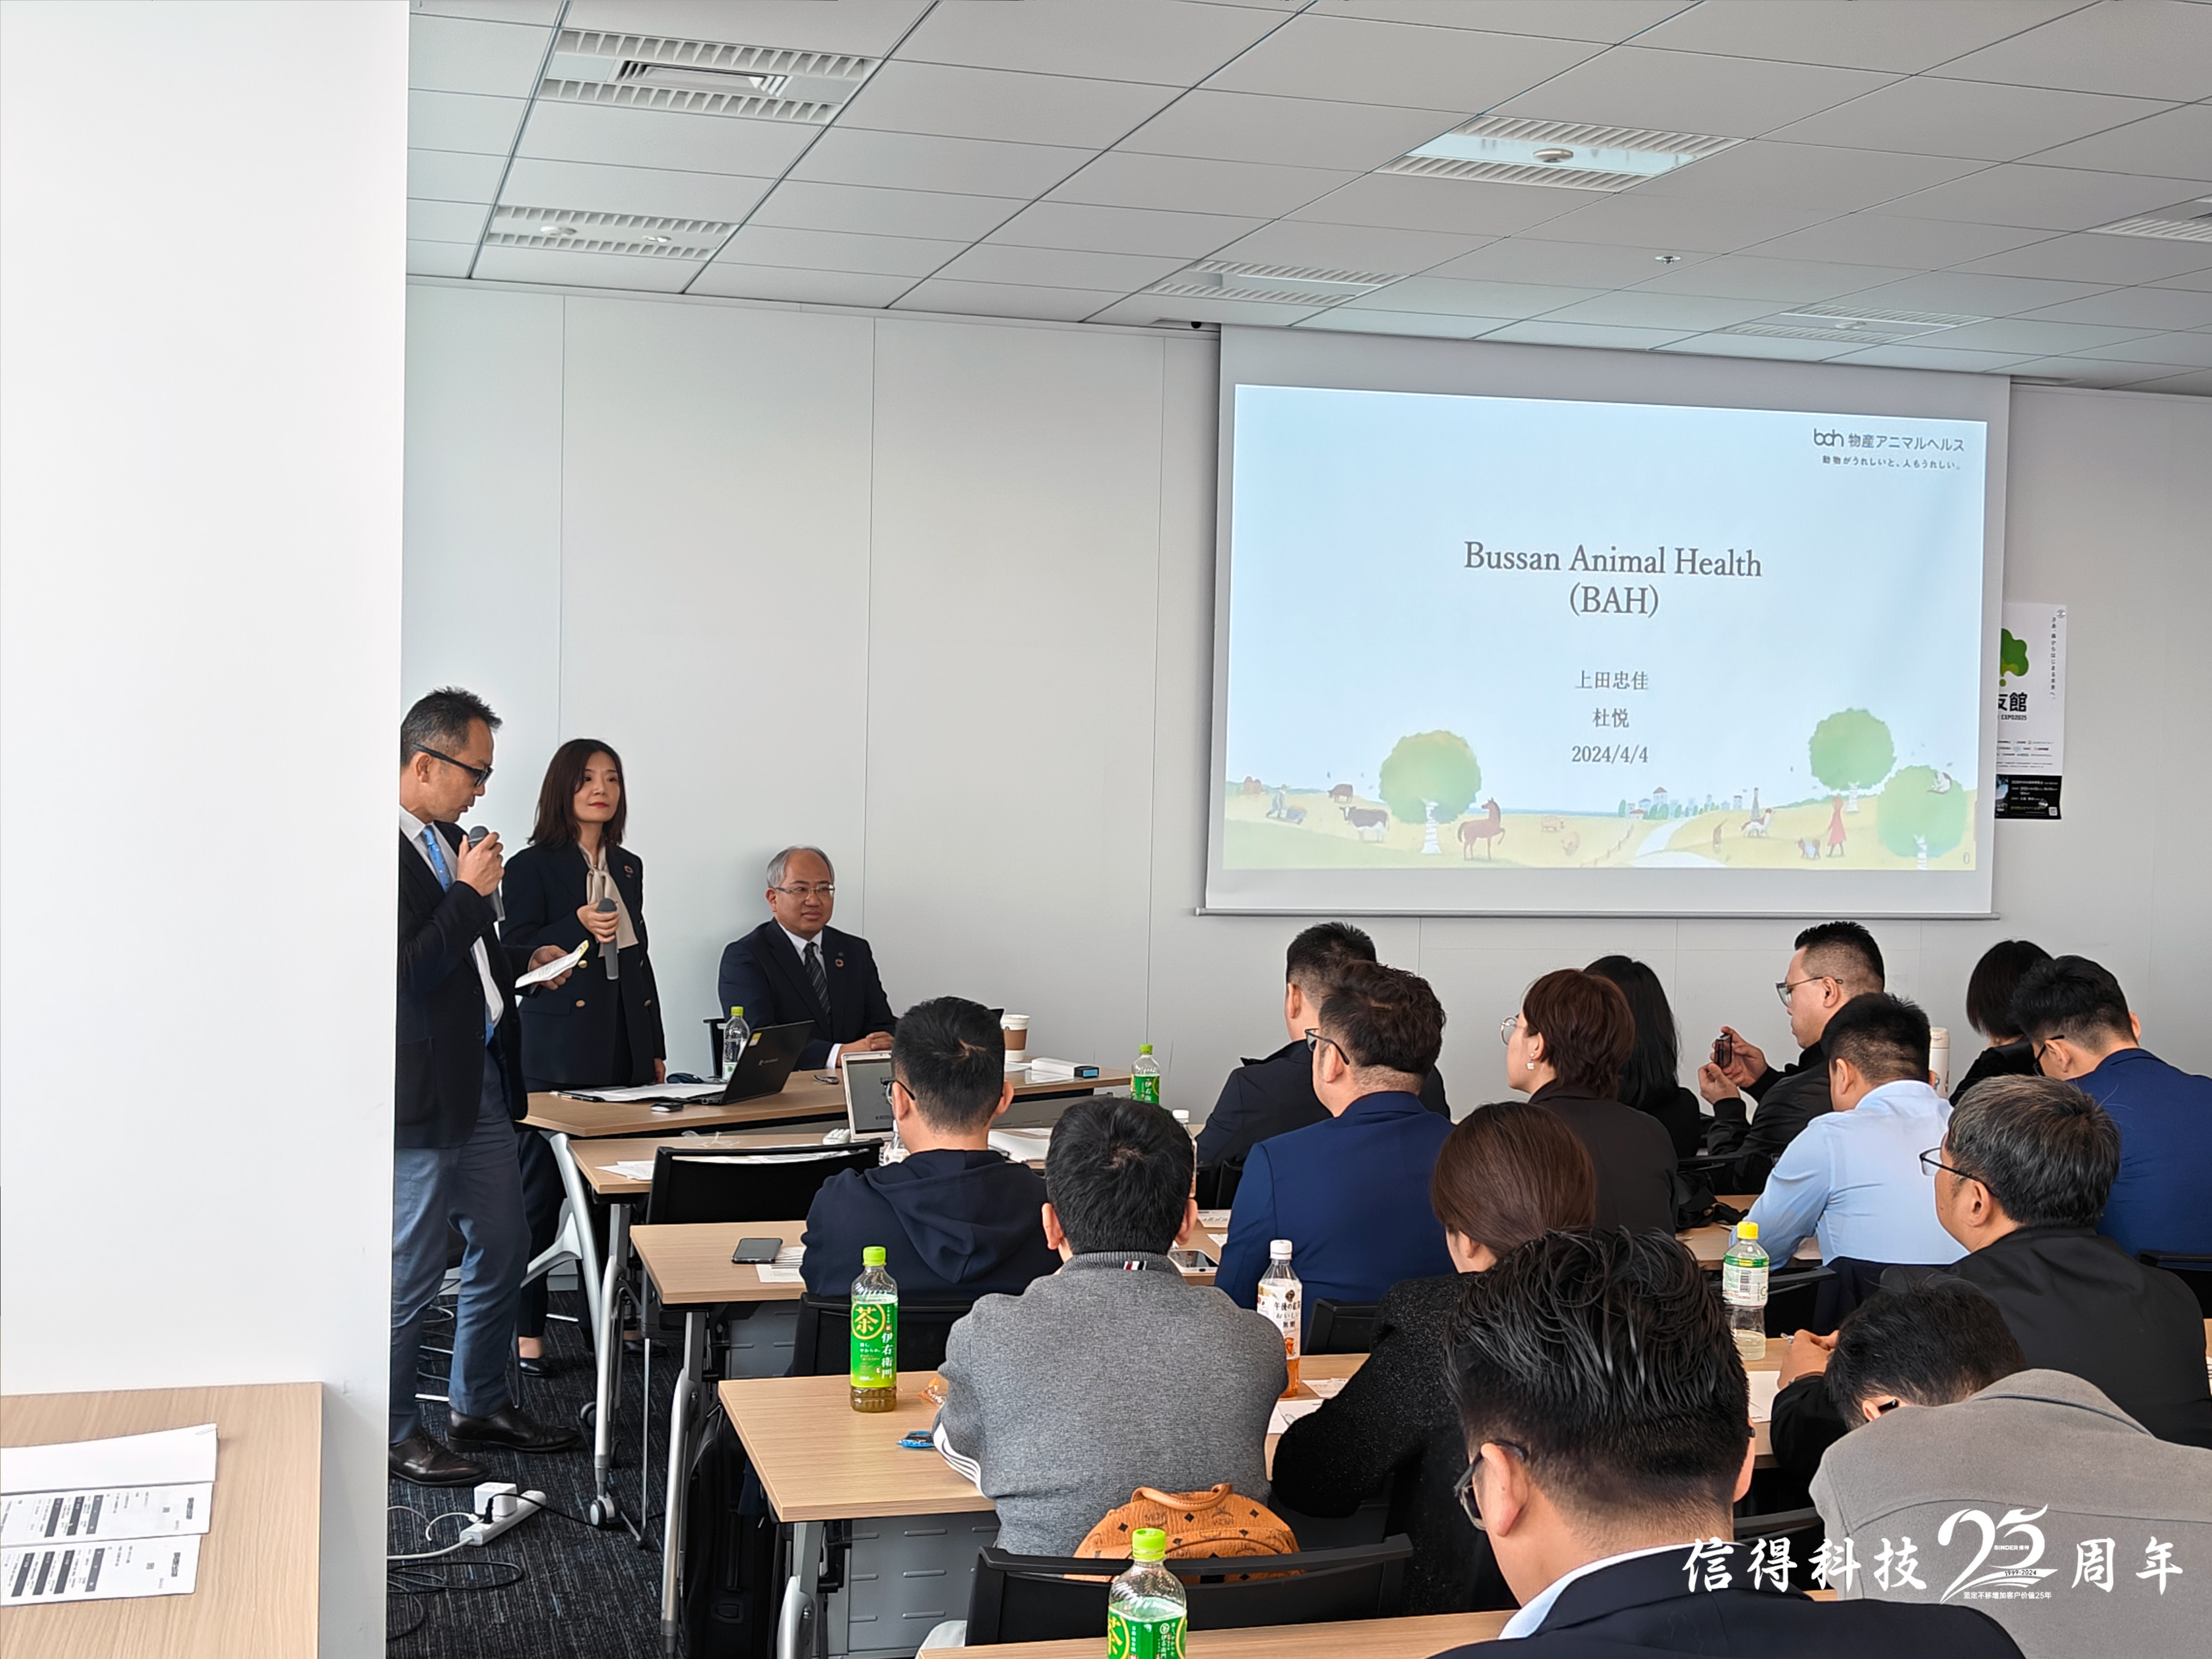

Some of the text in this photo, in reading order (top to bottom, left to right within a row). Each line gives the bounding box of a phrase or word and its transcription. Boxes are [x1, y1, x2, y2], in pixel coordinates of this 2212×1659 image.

[1848, 433, 1964, 451] 物産アニマルヘルス
[1822, 455, 1960, 470] 動物がうれしいと、人もうれしい。
[1464, 541, 1762, 577] Bussan Animal Health
[1570, 582, 1658, 618] (BAH)
[1575, 670, 1648, 690] 上田忠佳
[1593, 708, 1629, 728] 杜悦
[1572, 744, 1648, 764] 2024/4/4
[854, 1306, 879, 1335] 茶
[882, 1333, 893, 1379] 伊右衛門
